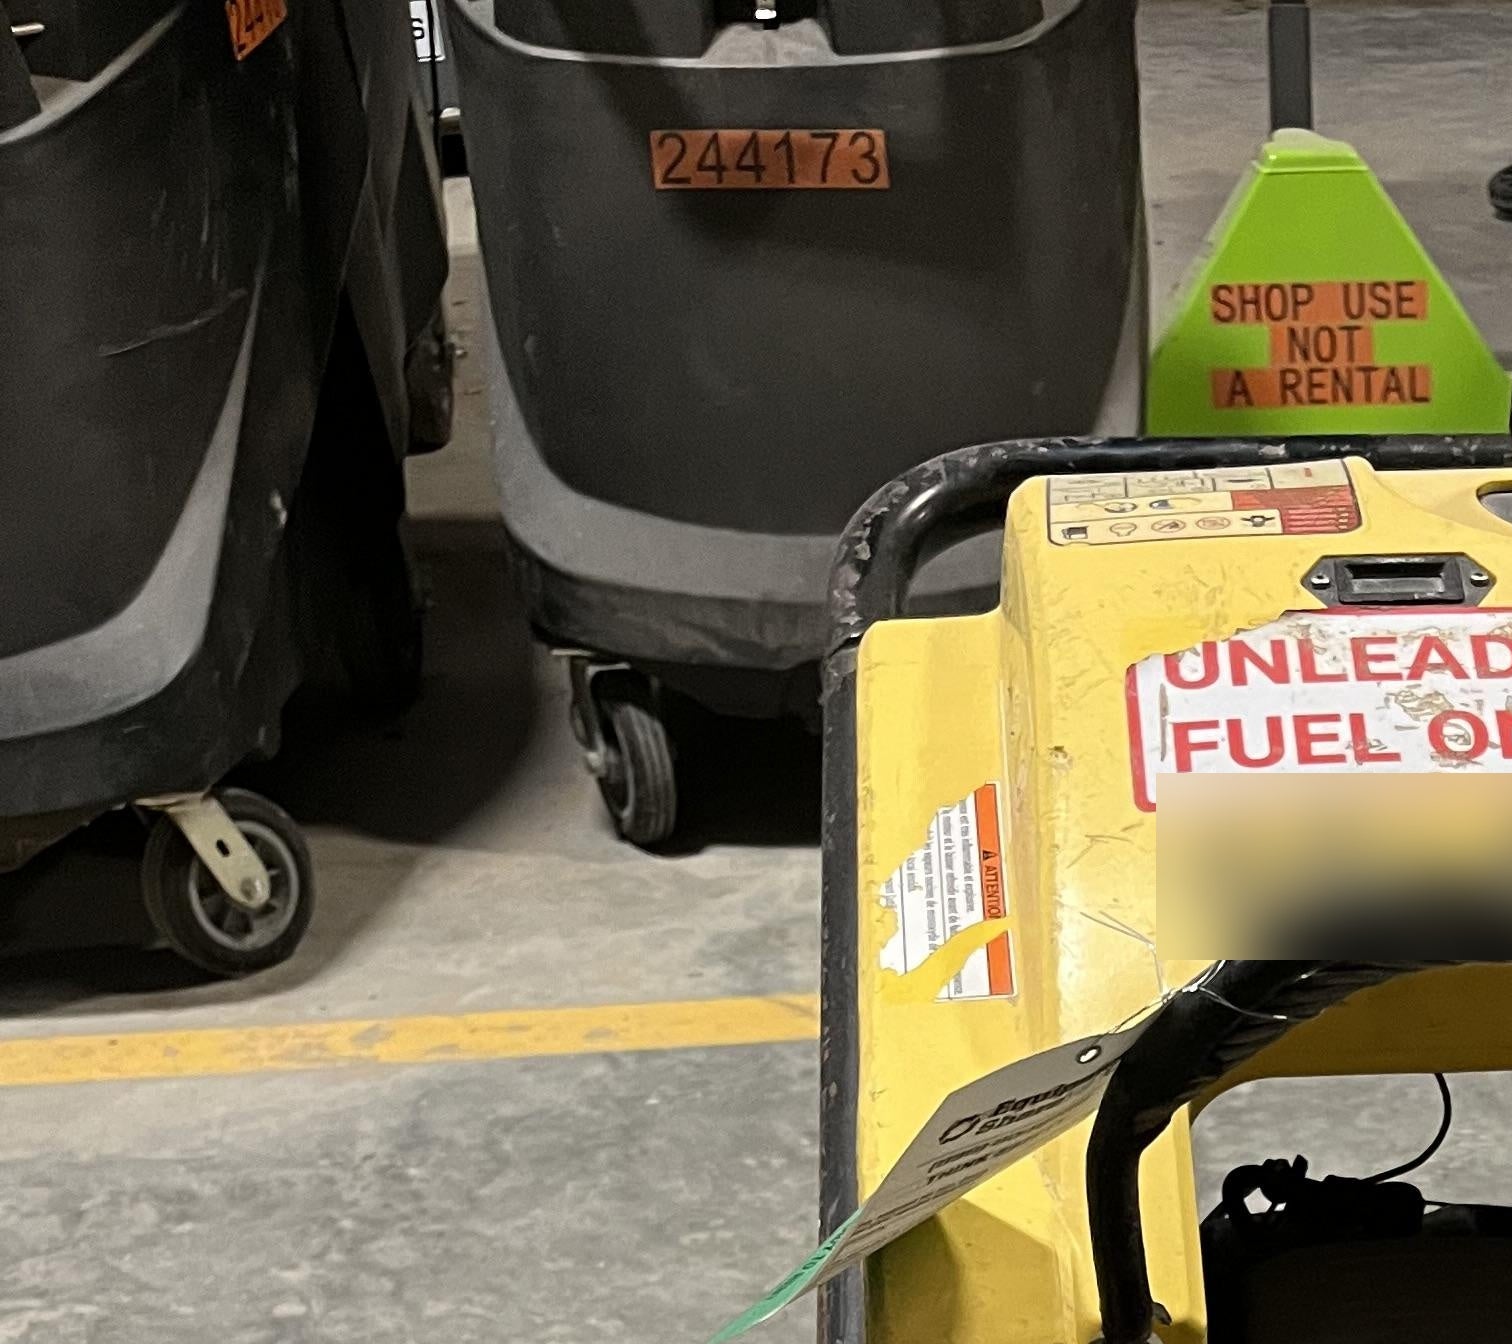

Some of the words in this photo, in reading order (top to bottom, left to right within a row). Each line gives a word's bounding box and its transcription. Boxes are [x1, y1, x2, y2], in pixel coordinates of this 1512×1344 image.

[657, 131, 881, 185] 244173
[1212, 283, 1315, 323] SHOP
[1341, 281, 1418, 320] USE
[1287, 325, 1362, 364] NOT
[1227, 370, 1254, 407] A
[1280, 365, 1432, 405] RENTAL
[1169, 712, 1401, 774] FUEL
